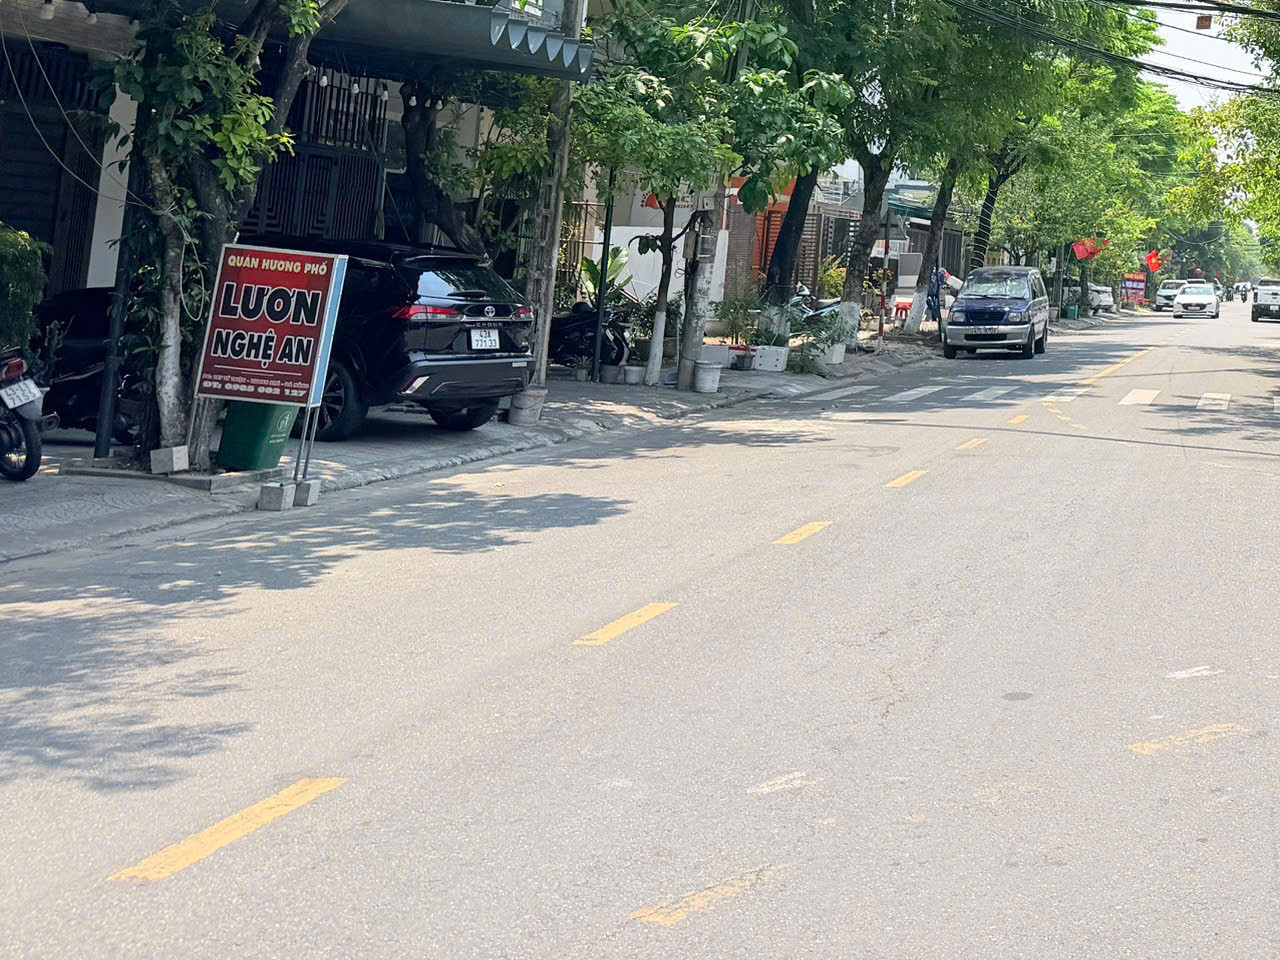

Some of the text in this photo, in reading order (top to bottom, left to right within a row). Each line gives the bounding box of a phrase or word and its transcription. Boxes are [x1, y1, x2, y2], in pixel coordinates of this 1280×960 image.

[228, 254, 328, 276] QUÁN HƯƠNG PHỐ
[219, 281, 322, 326] LƯƠN
[211, 328, 314, 369] NGHỆ AN
[224, 382, 255, 392] 0985
[283, 388, 308, 398] 127
